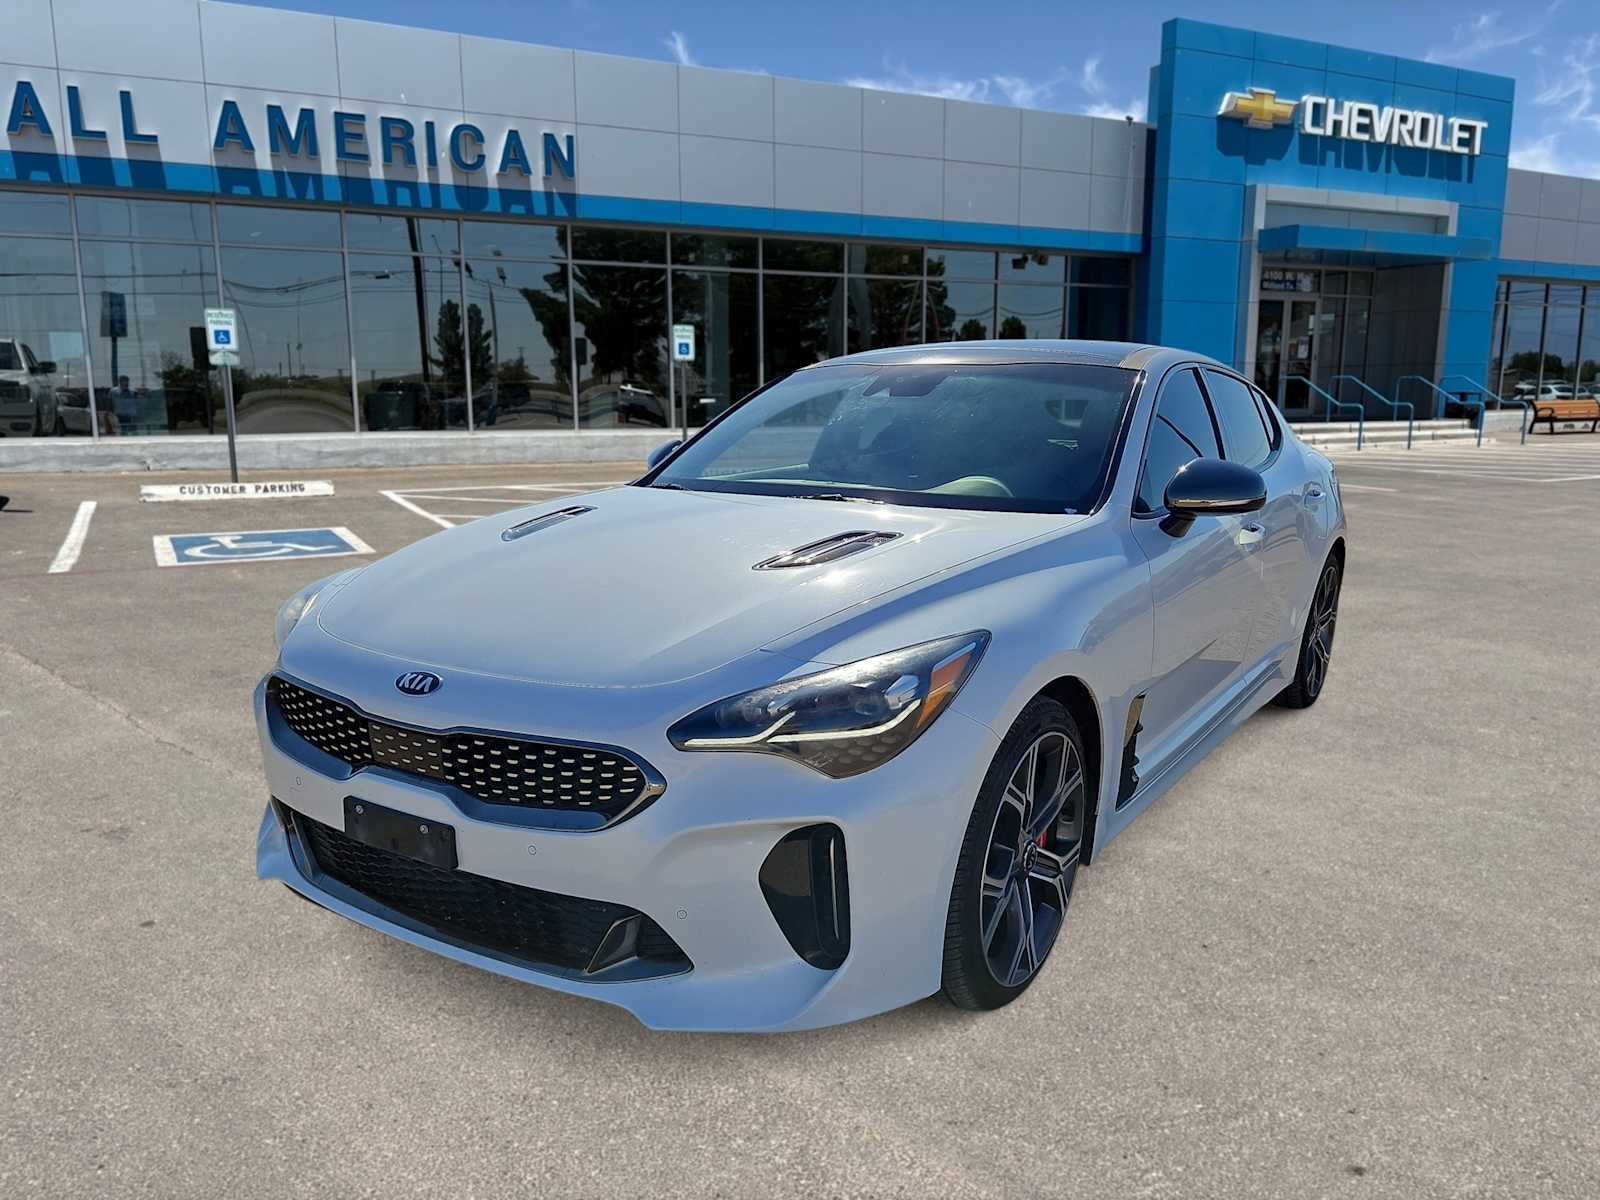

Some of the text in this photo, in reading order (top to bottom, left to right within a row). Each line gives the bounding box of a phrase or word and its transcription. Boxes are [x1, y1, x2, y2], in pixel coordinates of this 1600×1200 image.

[6, 80, 576, 179] ALL AMERICAN
[1301, 95, 1488, 155] CHEVROLET
[179, 483, 306, 495] CUSTOMER PARKING
[398, 673, 433, 692] KIA
